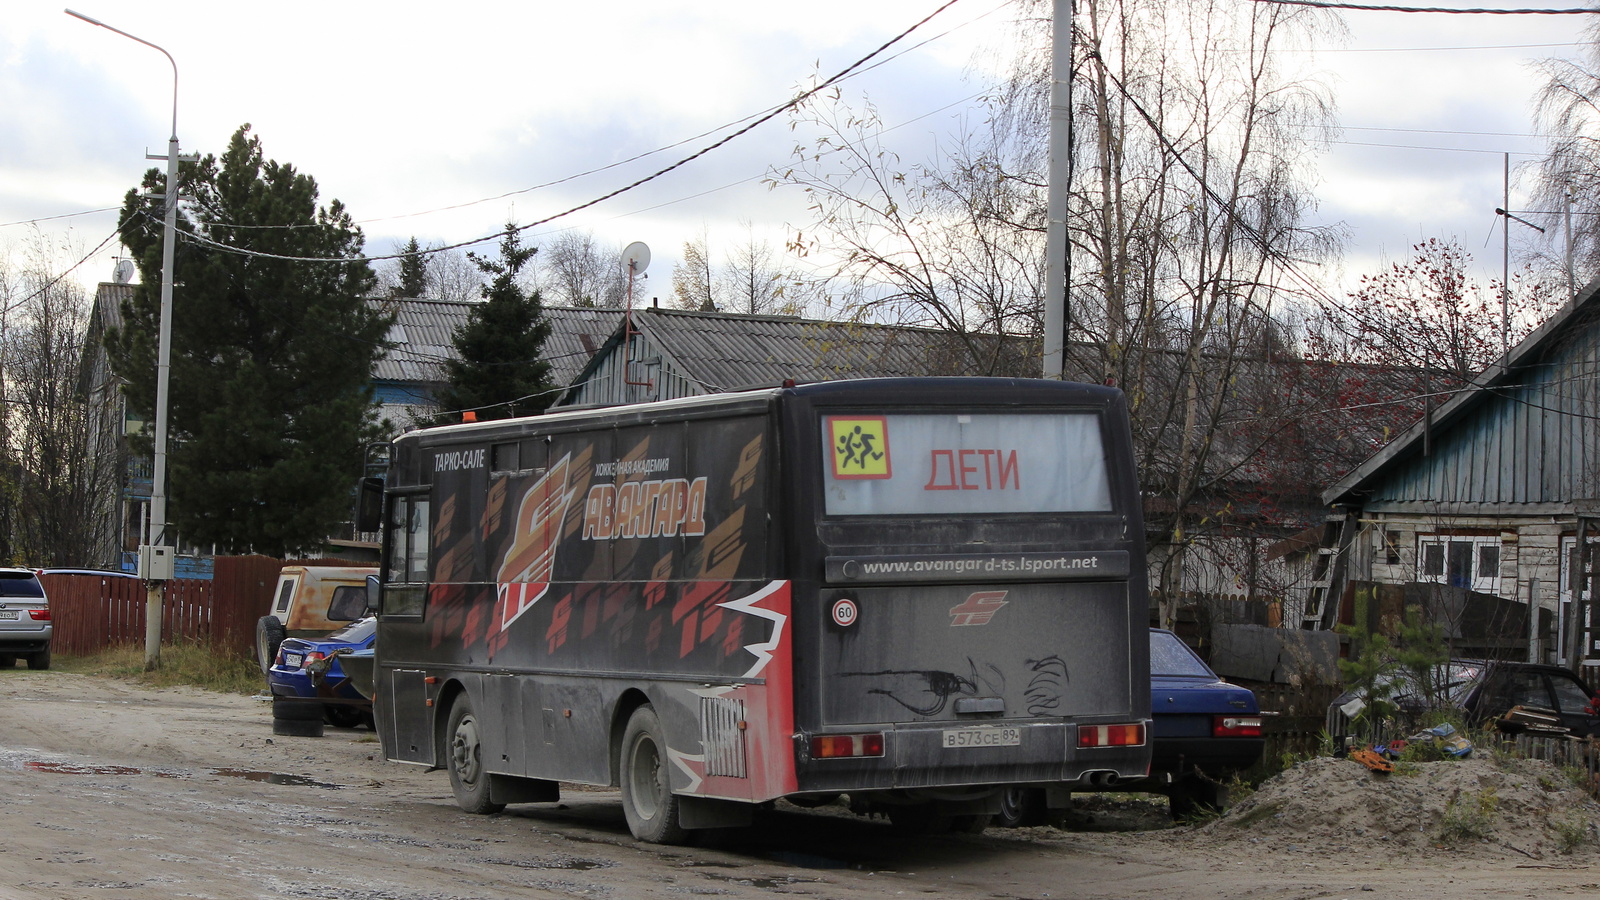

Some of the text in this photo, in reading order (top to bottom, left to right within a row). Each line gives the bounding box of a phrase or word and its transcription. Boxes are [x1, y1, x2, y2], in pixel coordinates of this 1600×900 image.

[434, 449, 485, 472] ТАРКО-САЛЕ
[595, 458, 669, 476] ХОККЕЙНАЯ АКАДЕМИЯ
[924, 449, 1020, 491] ДЕТИ
[582, 476, 707, 540] АВАНГАРД
[838, 607, 852, 618] 60
